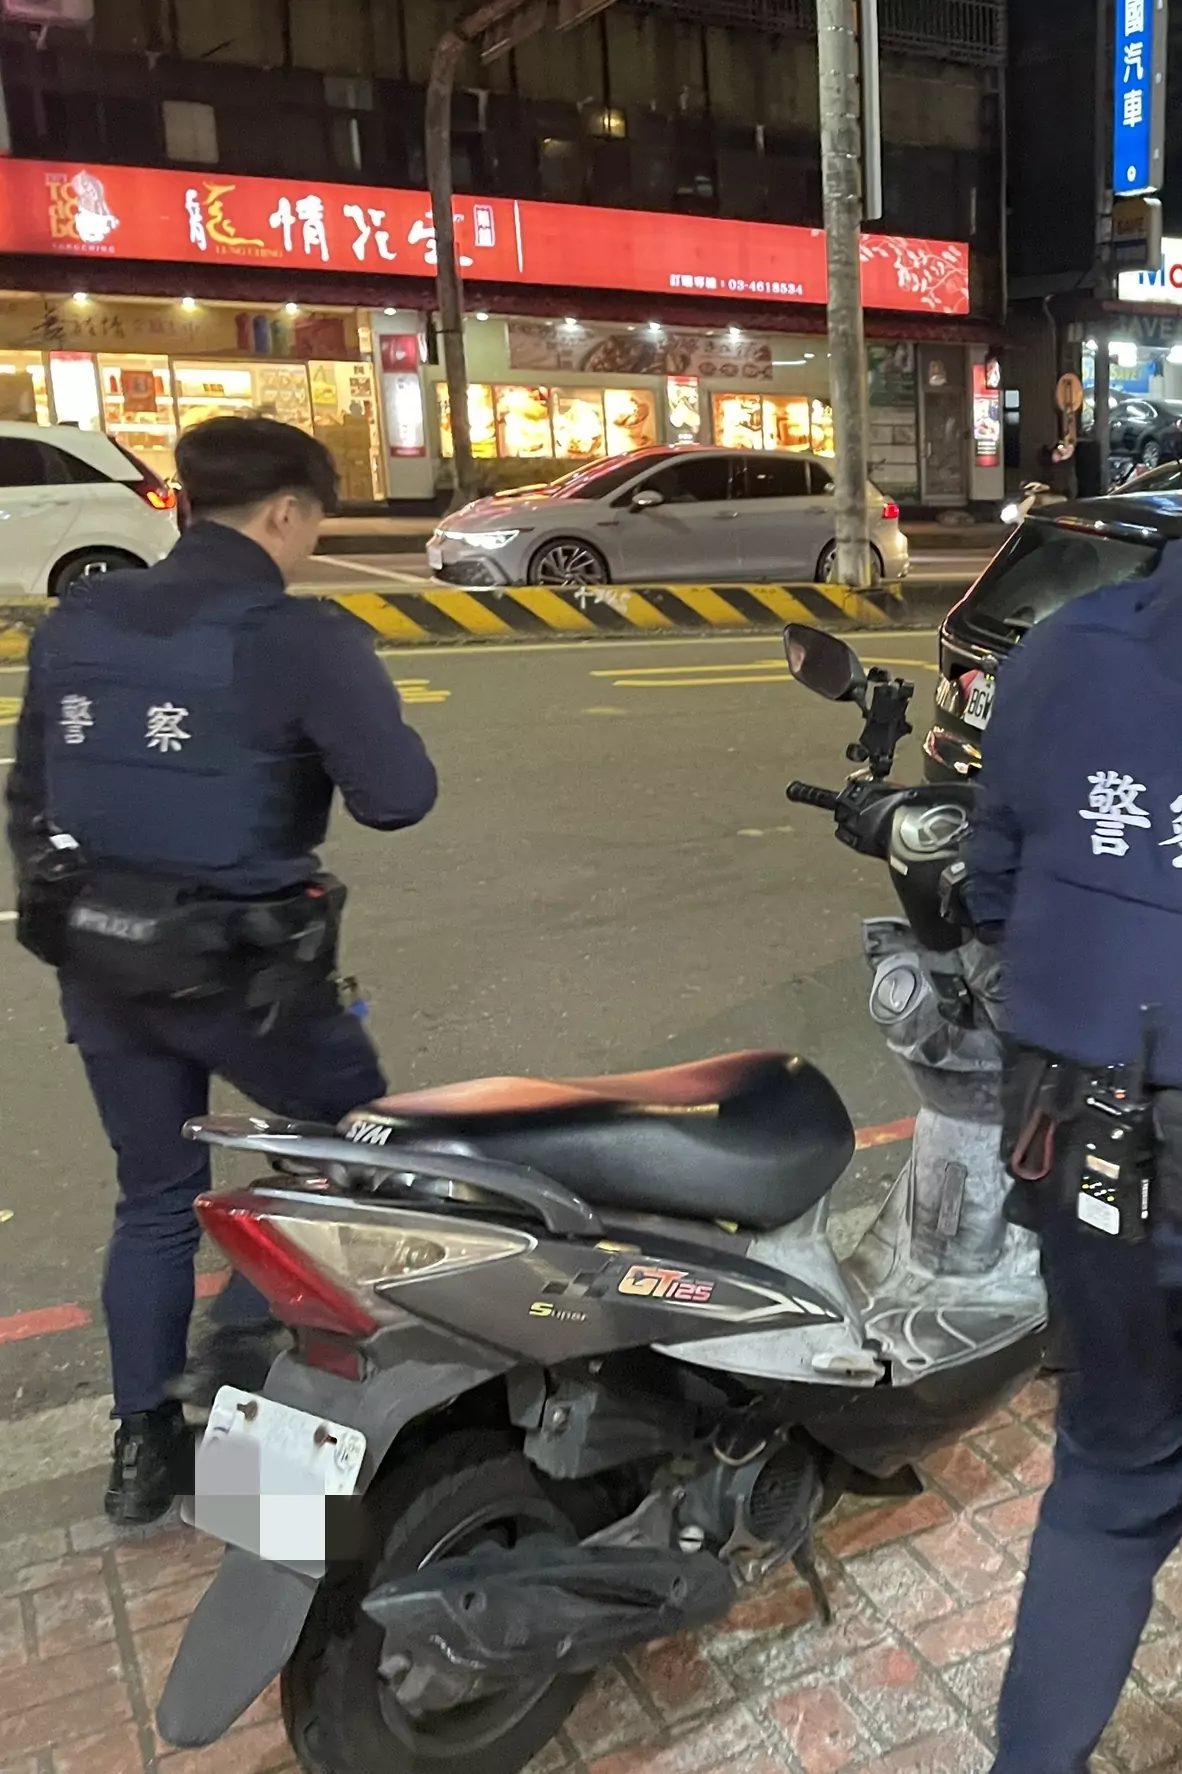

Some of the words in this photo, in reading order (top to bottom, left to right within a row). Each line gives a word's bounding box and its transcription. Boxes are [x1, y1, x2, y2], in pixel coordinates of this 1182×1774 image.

[58, 693, 192, 753] 警察
[345, 1120, 393, 1147] SYM
[528, 1301, 588, 1323] Super
